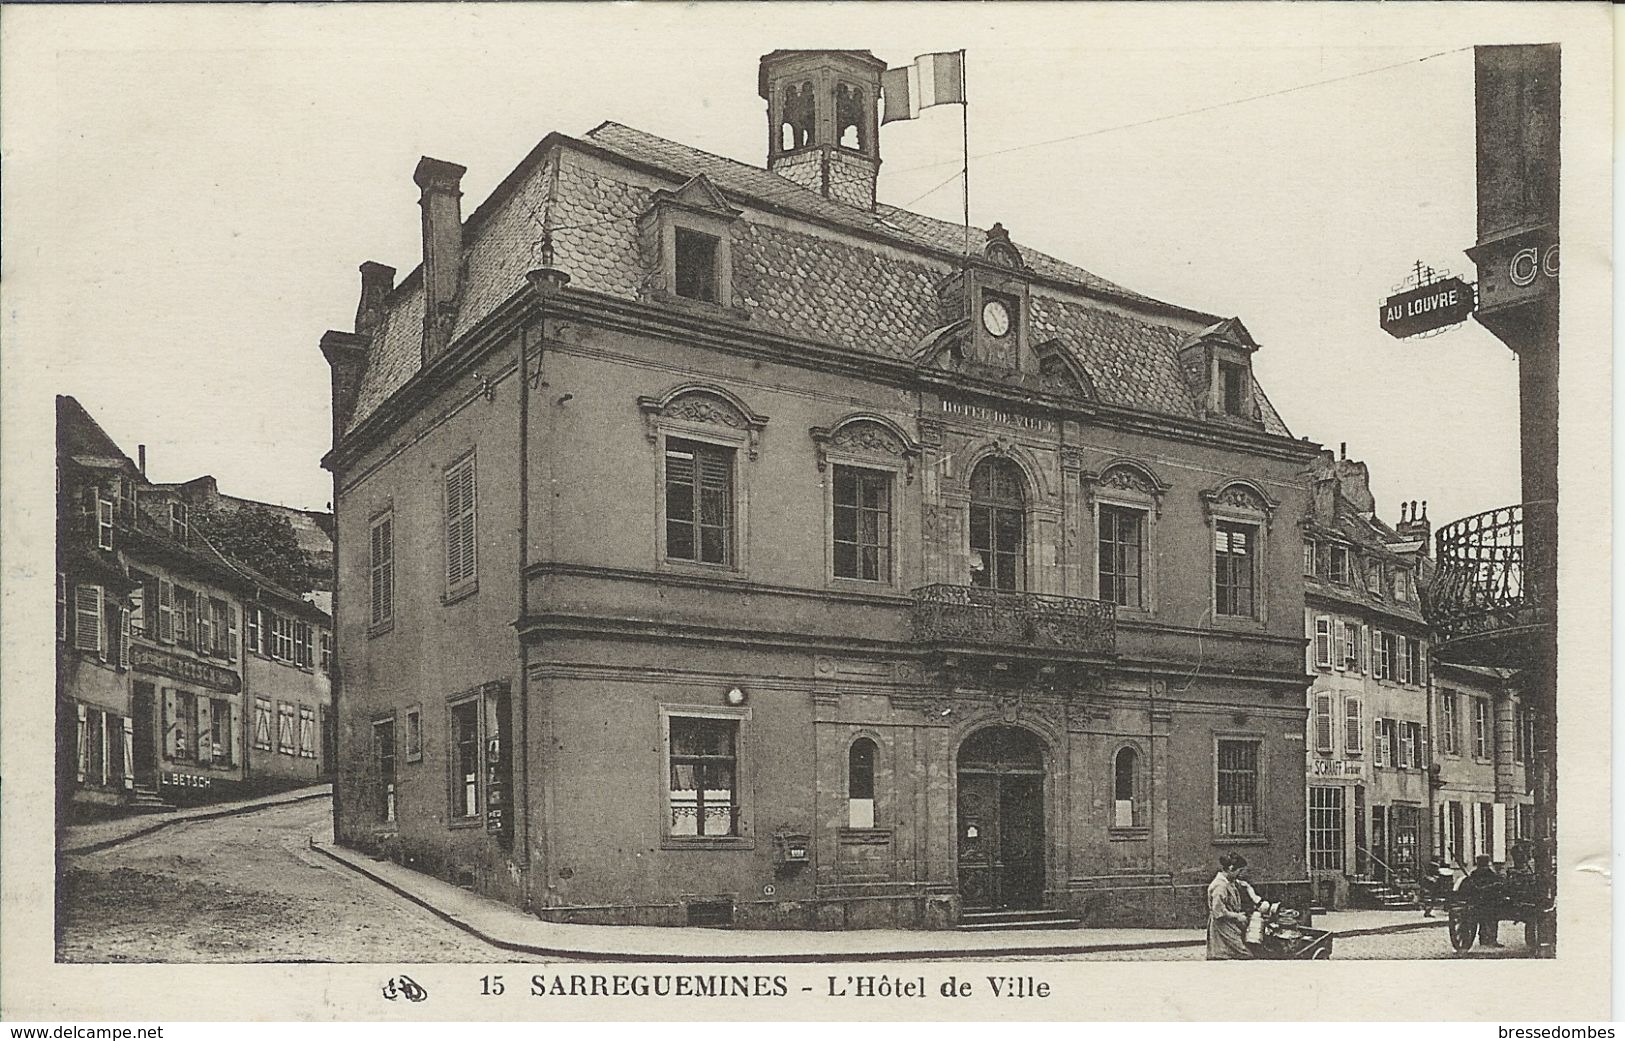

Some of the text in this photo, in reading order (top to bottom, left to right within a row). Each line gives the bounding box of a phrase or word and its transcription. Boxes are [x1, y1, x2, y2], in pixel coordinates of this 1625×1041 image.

[1386, 289, 1458, 322] AU LOUVRE
[480, 976, 505, 996] 15
[532, 976, 788, 998] SARREGUEMINES
[828, 974, 926, 998] L'Hôtel
[941, 976, 972, 998] de
[987, 976, 1051, 998] Ville
